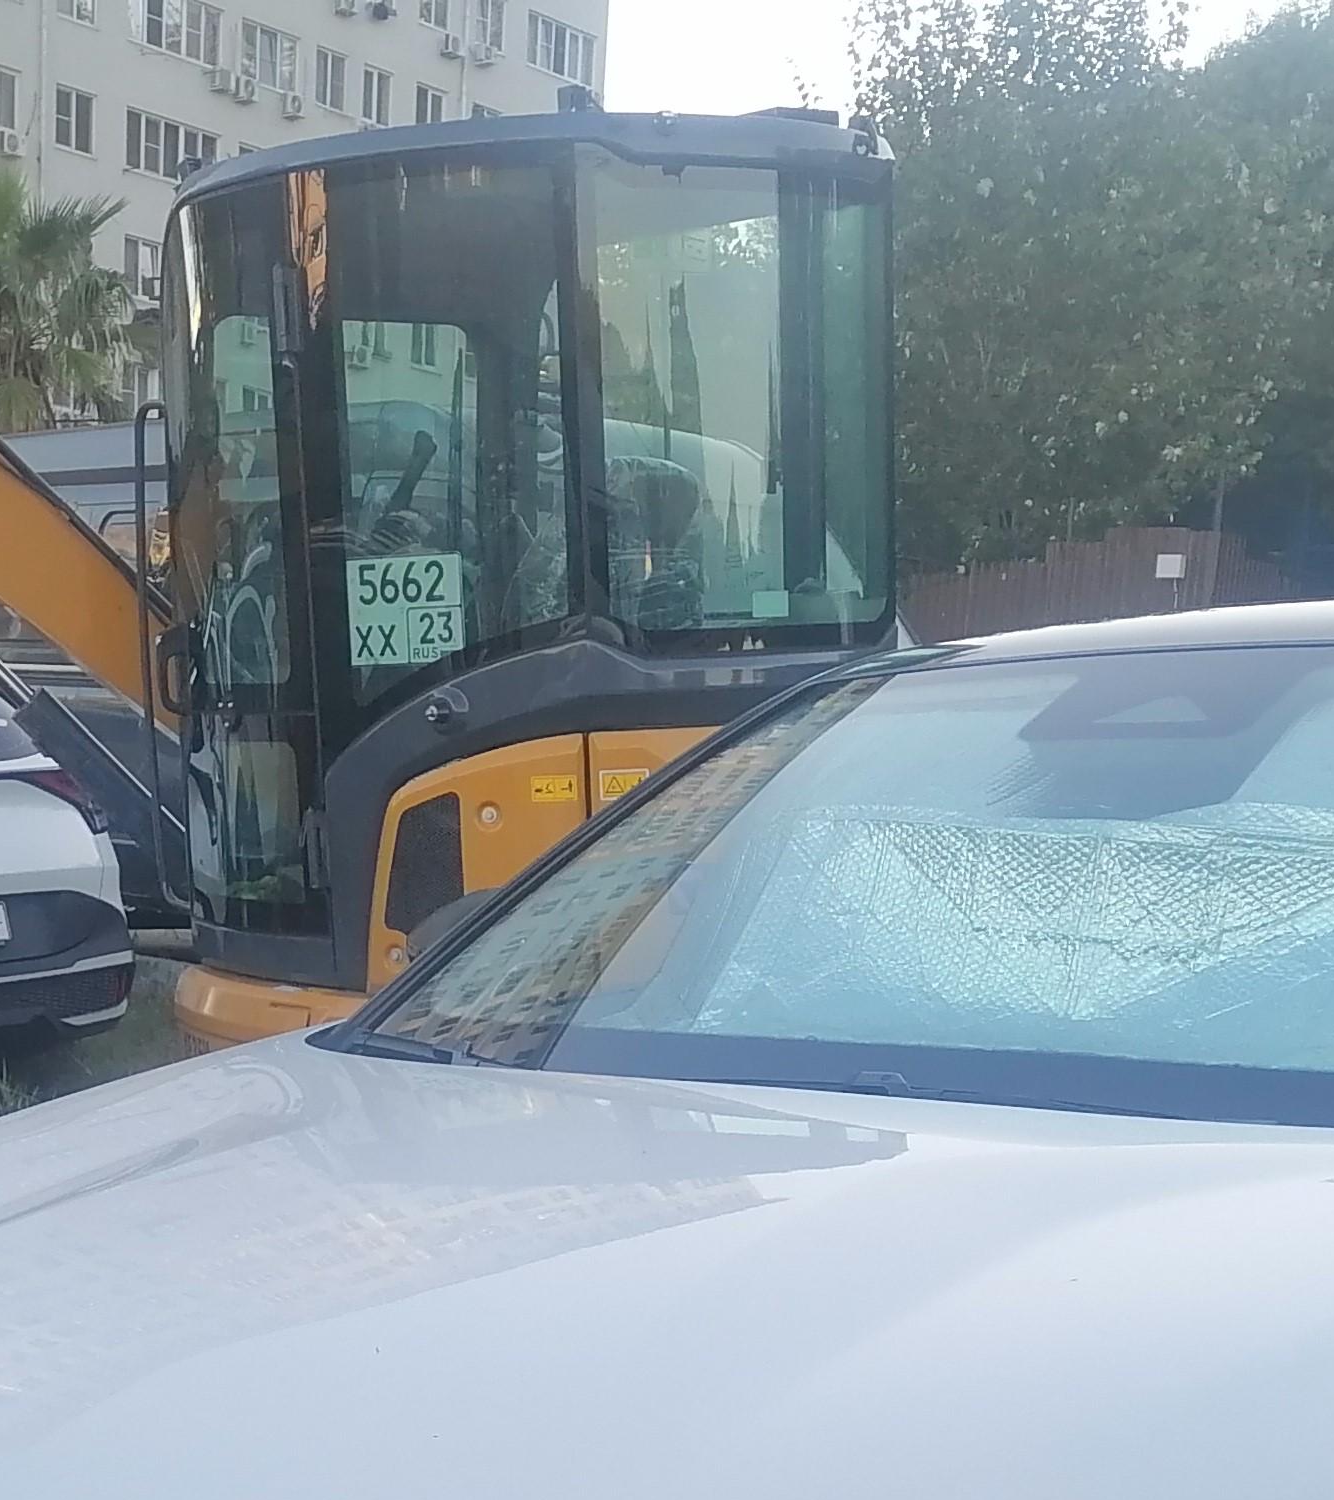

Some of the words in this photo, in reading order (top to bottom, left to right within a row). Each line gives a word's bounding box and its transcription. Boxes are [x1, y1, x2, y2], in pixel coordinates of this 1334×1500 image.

[358, 560, 445, 605] 5662
[356, 624, 397, 658] ХХ
[420, 611, 453, 644] 23
[413, 647, 439, 659] RUS
